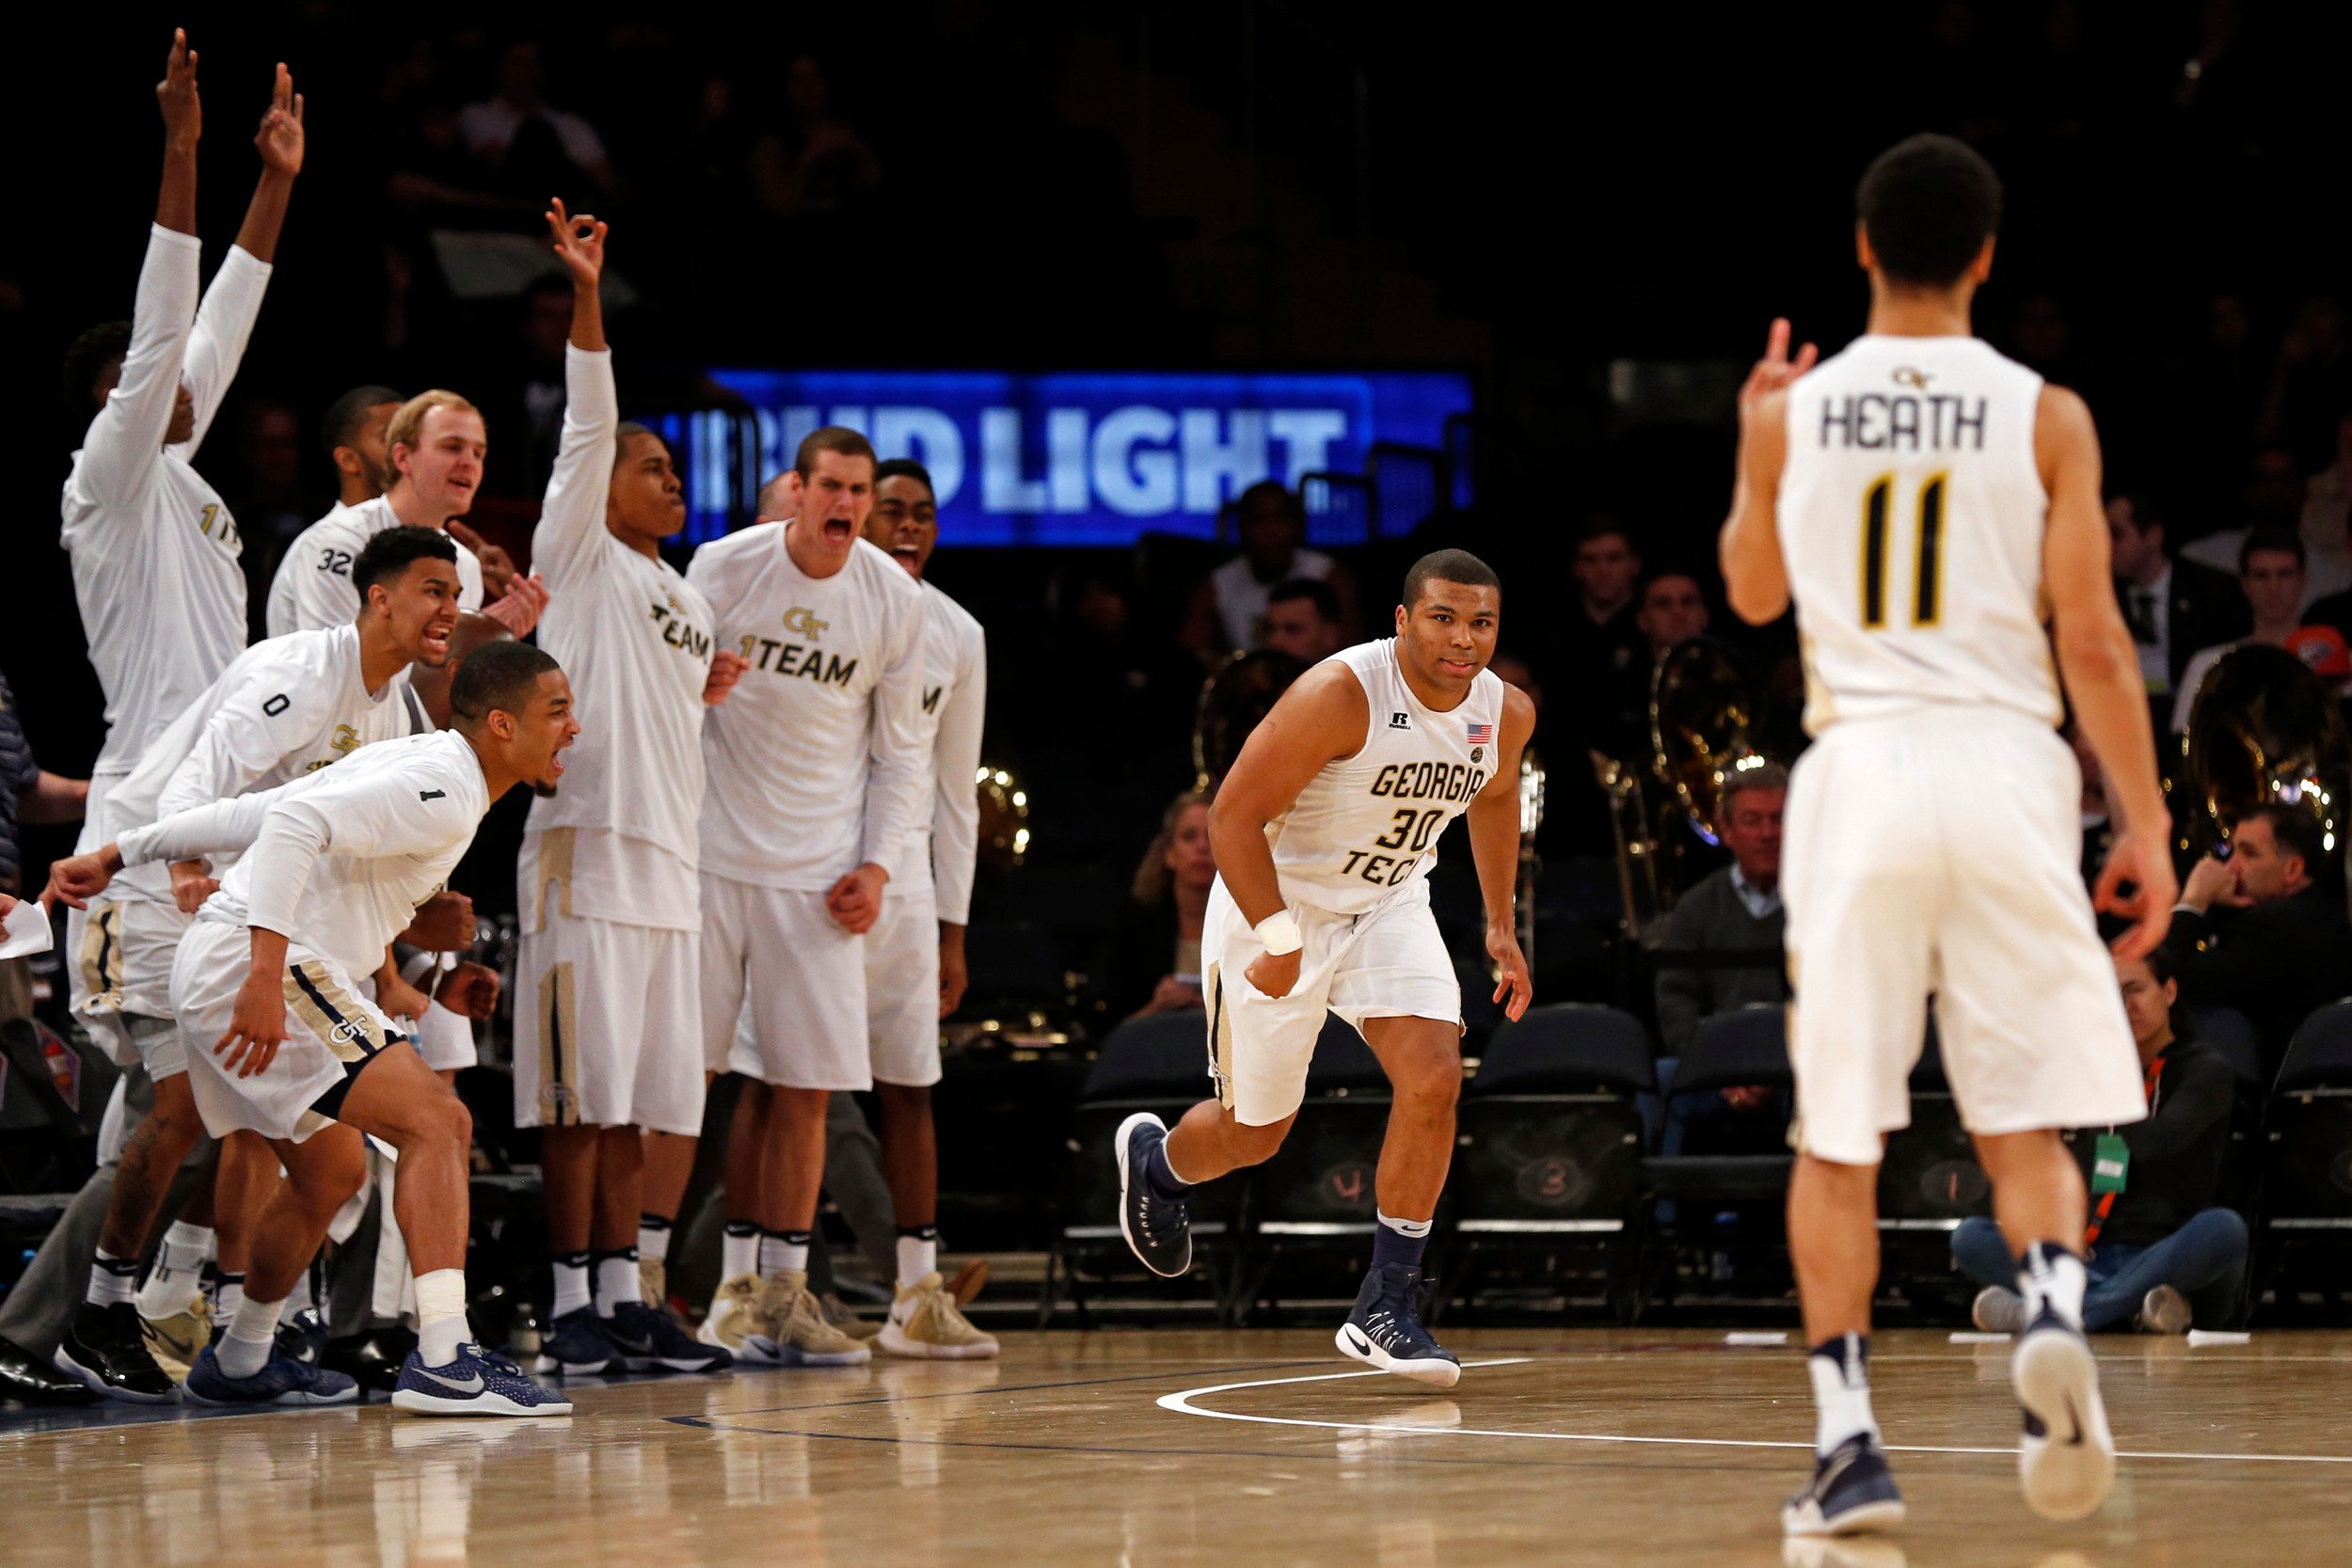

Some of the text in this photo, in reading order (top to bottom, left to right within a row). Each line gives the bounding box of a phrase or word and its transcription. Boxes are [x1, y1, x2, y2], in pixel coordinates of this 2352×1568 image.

[1820, 393, 1987, 450] HEATH
[979, 404, 1348, 516] LIGHT
[317, 548, 352, 576] 32
[1859, 469, 1950, 630] 11
[783, 607, 829, 641] GT
[262, 693, 290, 717] 0
[419, 789, 446, 801] 1
[1371, 761, 1486, 803] GEORGIA
[1375, 808, 1446, 852] 30
[1341, 849, 1421, 887] TEC
[328, 1014, 369, 1044] GT
